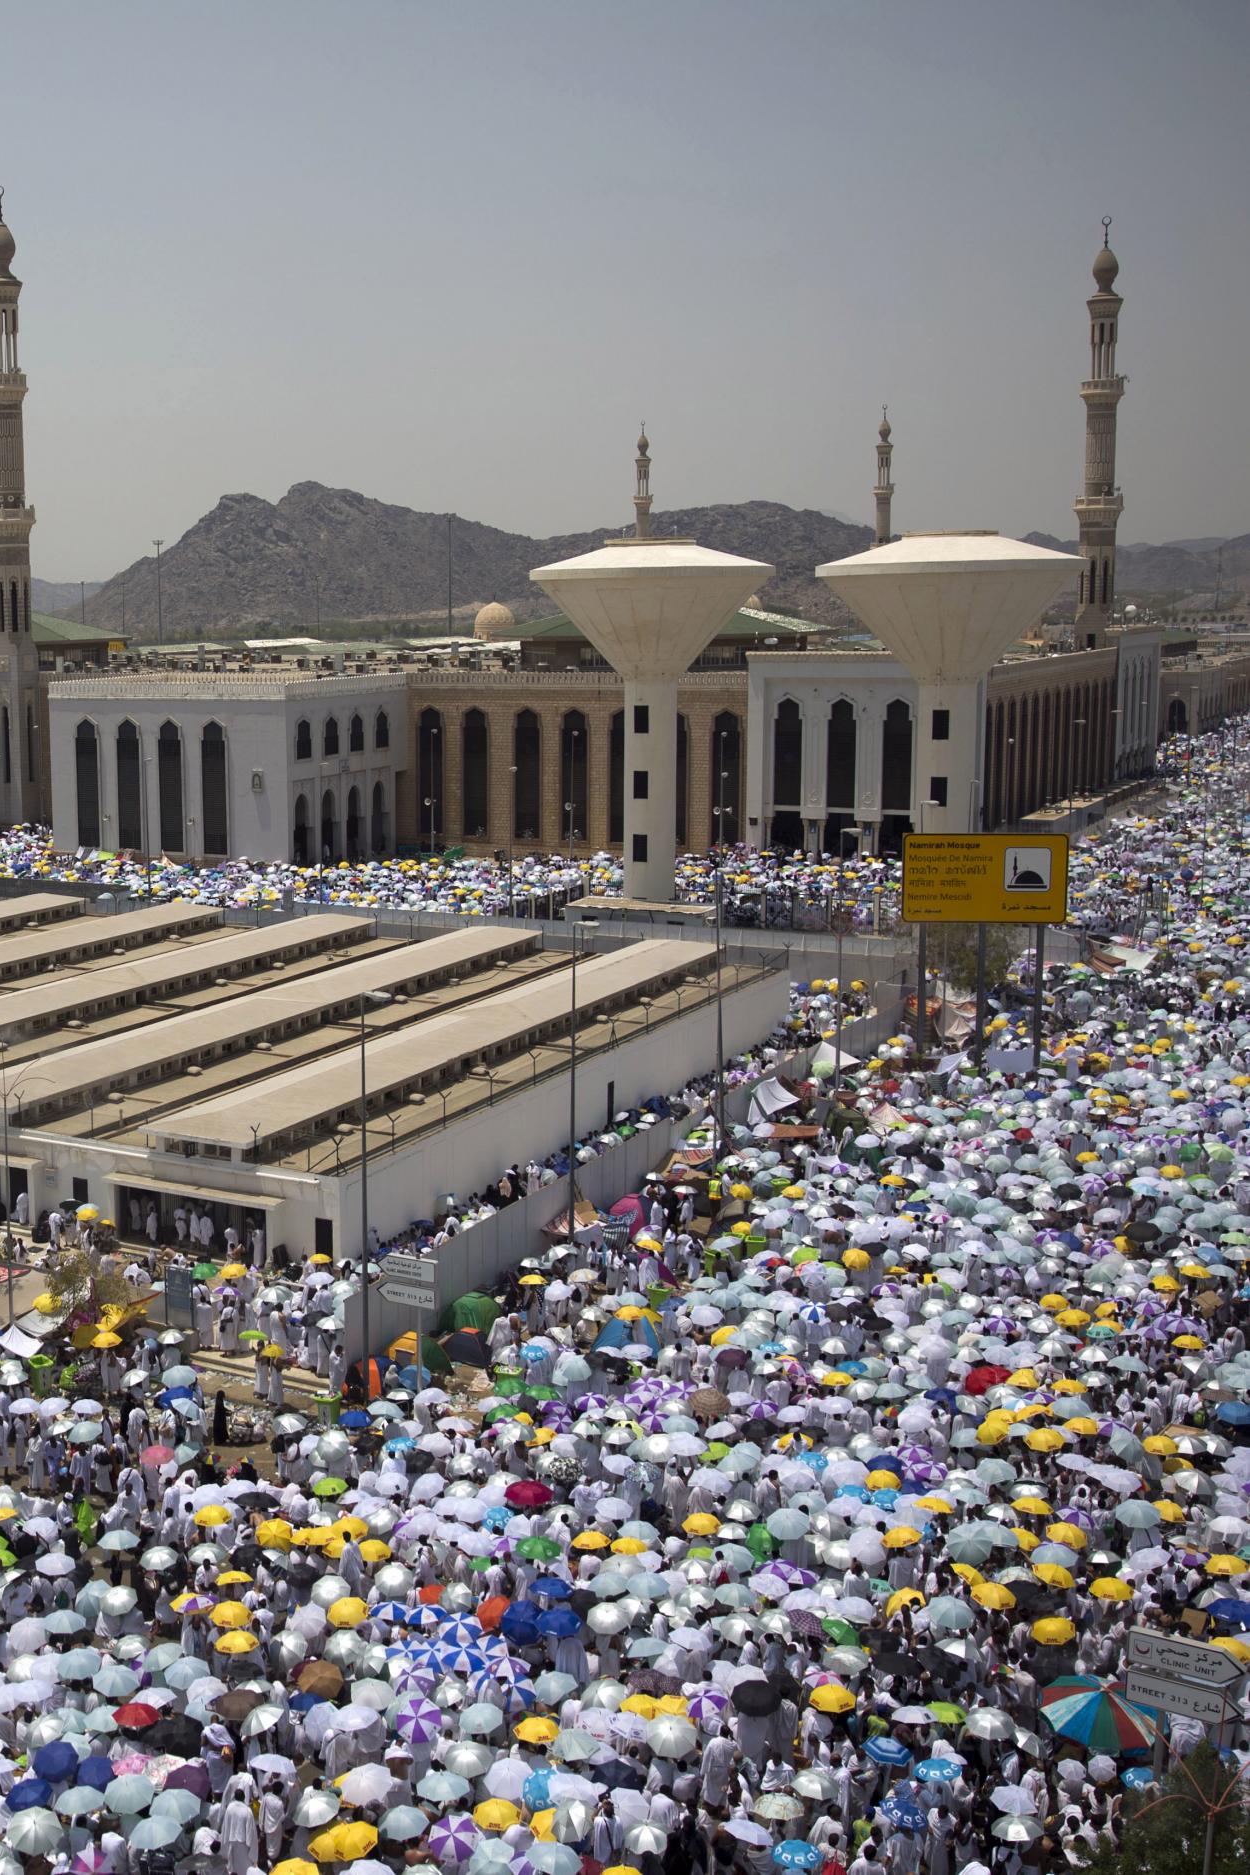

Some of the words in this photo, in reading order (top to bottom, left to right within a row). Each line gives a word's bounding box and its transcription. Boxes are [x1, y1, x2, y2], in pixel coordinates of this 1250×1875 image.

[947, 842, 980, 850] Mosque
[909, 854, 947, 863] Mosquée
[1021, 904, 1051, 912] مسجد
[386, 1289, 405, 1297] STREET
[1156, 1647, 1190, 1659] صحي
[1194, 1653, 1223, 1666] مركز
[1160, 1657, 1190, 1670] CLINIC
[1194, 1666, 1217, 1677] UNIT
[1131, 1684, 1166, 1699] STREET
[1169, 1694, 1188, 1705] 313
[1192, 1701, 1221, 1714] شارع
